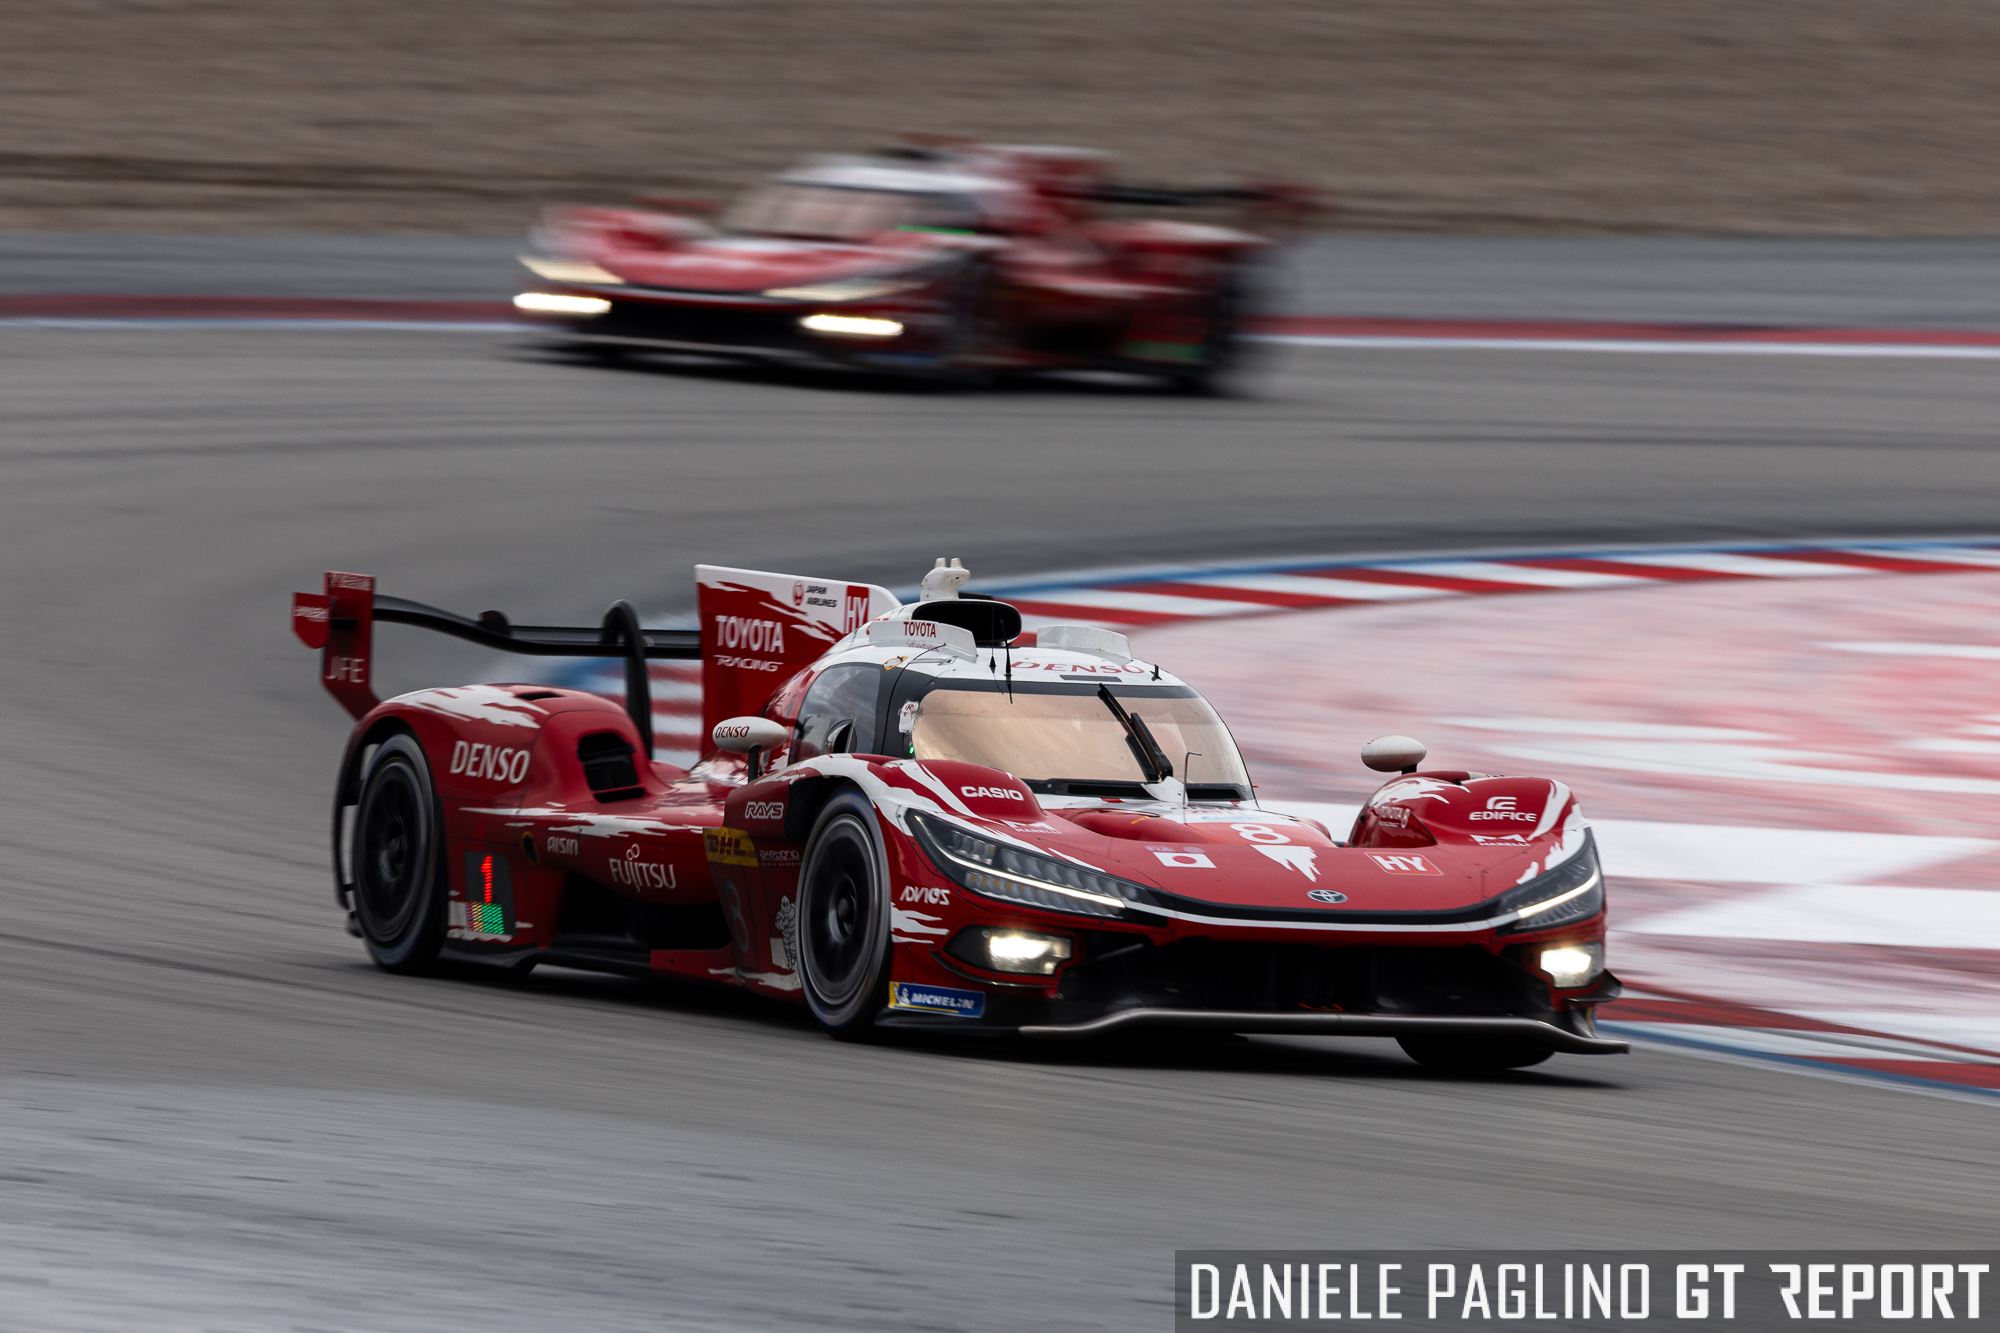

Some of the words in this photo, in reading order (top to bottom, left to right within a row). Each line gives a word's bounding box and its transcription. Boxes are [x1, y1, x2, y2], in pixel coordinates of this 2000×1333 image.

[805, 597, 838, 608] AIRLINES
[845, 595, 868, 634] HY
[715, 615, 785, 654] TOYOTA
[903, 621, 937, 638] TOYOTA
[713, 654, 784, 672] RACING
[1010, 661, 1145, 674] DENSO
[715, 726, 750, 739] DENSO
[450, 740, 531, 785] DENSO
[960, 785, 1025, 801] CASIO
[745, 802, 784, 819] RAYS
[1469, 811, 1537, 822] EDIFICE
[1230, 823, 1291, 844] 8
[706, 833, 747, 857] DHL
[1373, 855, 1428, 872] HY
[609, 857, 677, 893] FUJITSU
[724, 878, 750, 955] 8
[910, 992, 975, 1010] MICHELIN
